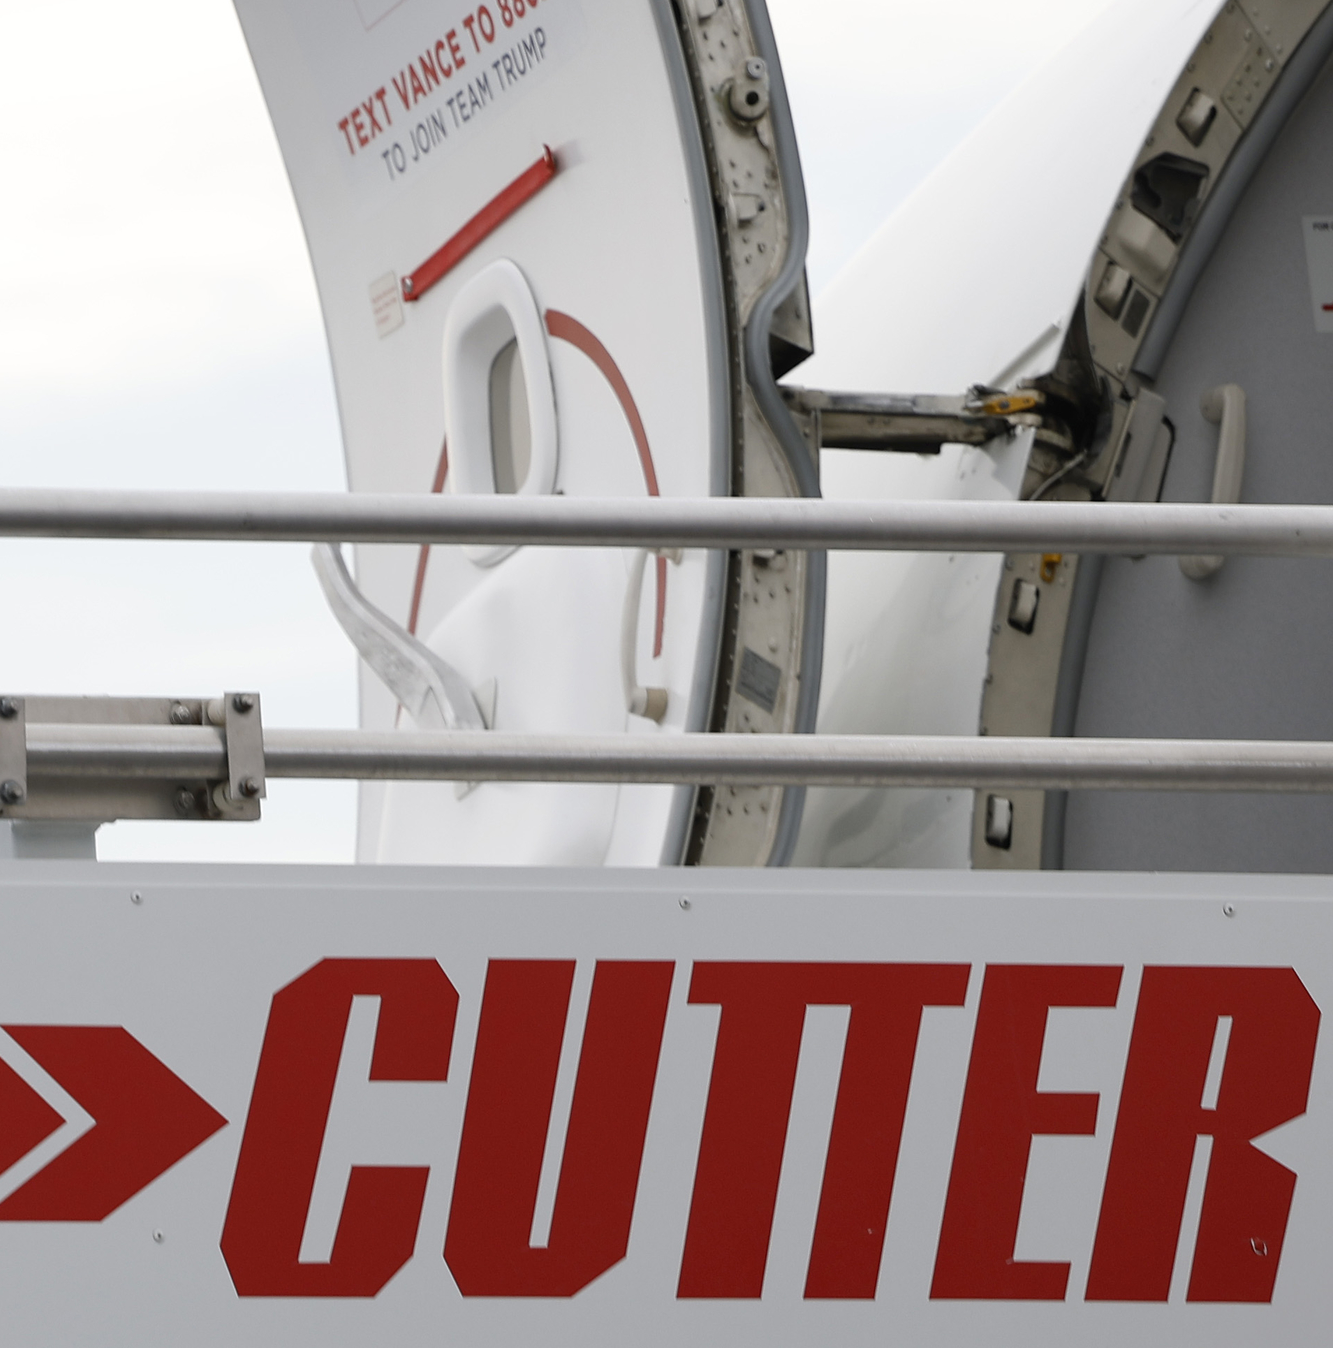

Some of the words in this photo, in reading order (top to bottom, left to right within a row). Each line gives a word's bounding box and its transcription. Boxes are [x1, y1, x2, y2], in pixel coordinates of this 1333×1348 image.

[338, 87, 393, 155] TEXT
[392, 29, 466, 111] VANCE
[463, 4, 495, 53] TO
[382, 142, 406, 181] TO
[410, 113, 447, 162] JOIN
[446, 72, 492, 129] TEAM
[492, 27, 547, 92] TRUMP
[219, 957, 1322, 1304] CUTTER
